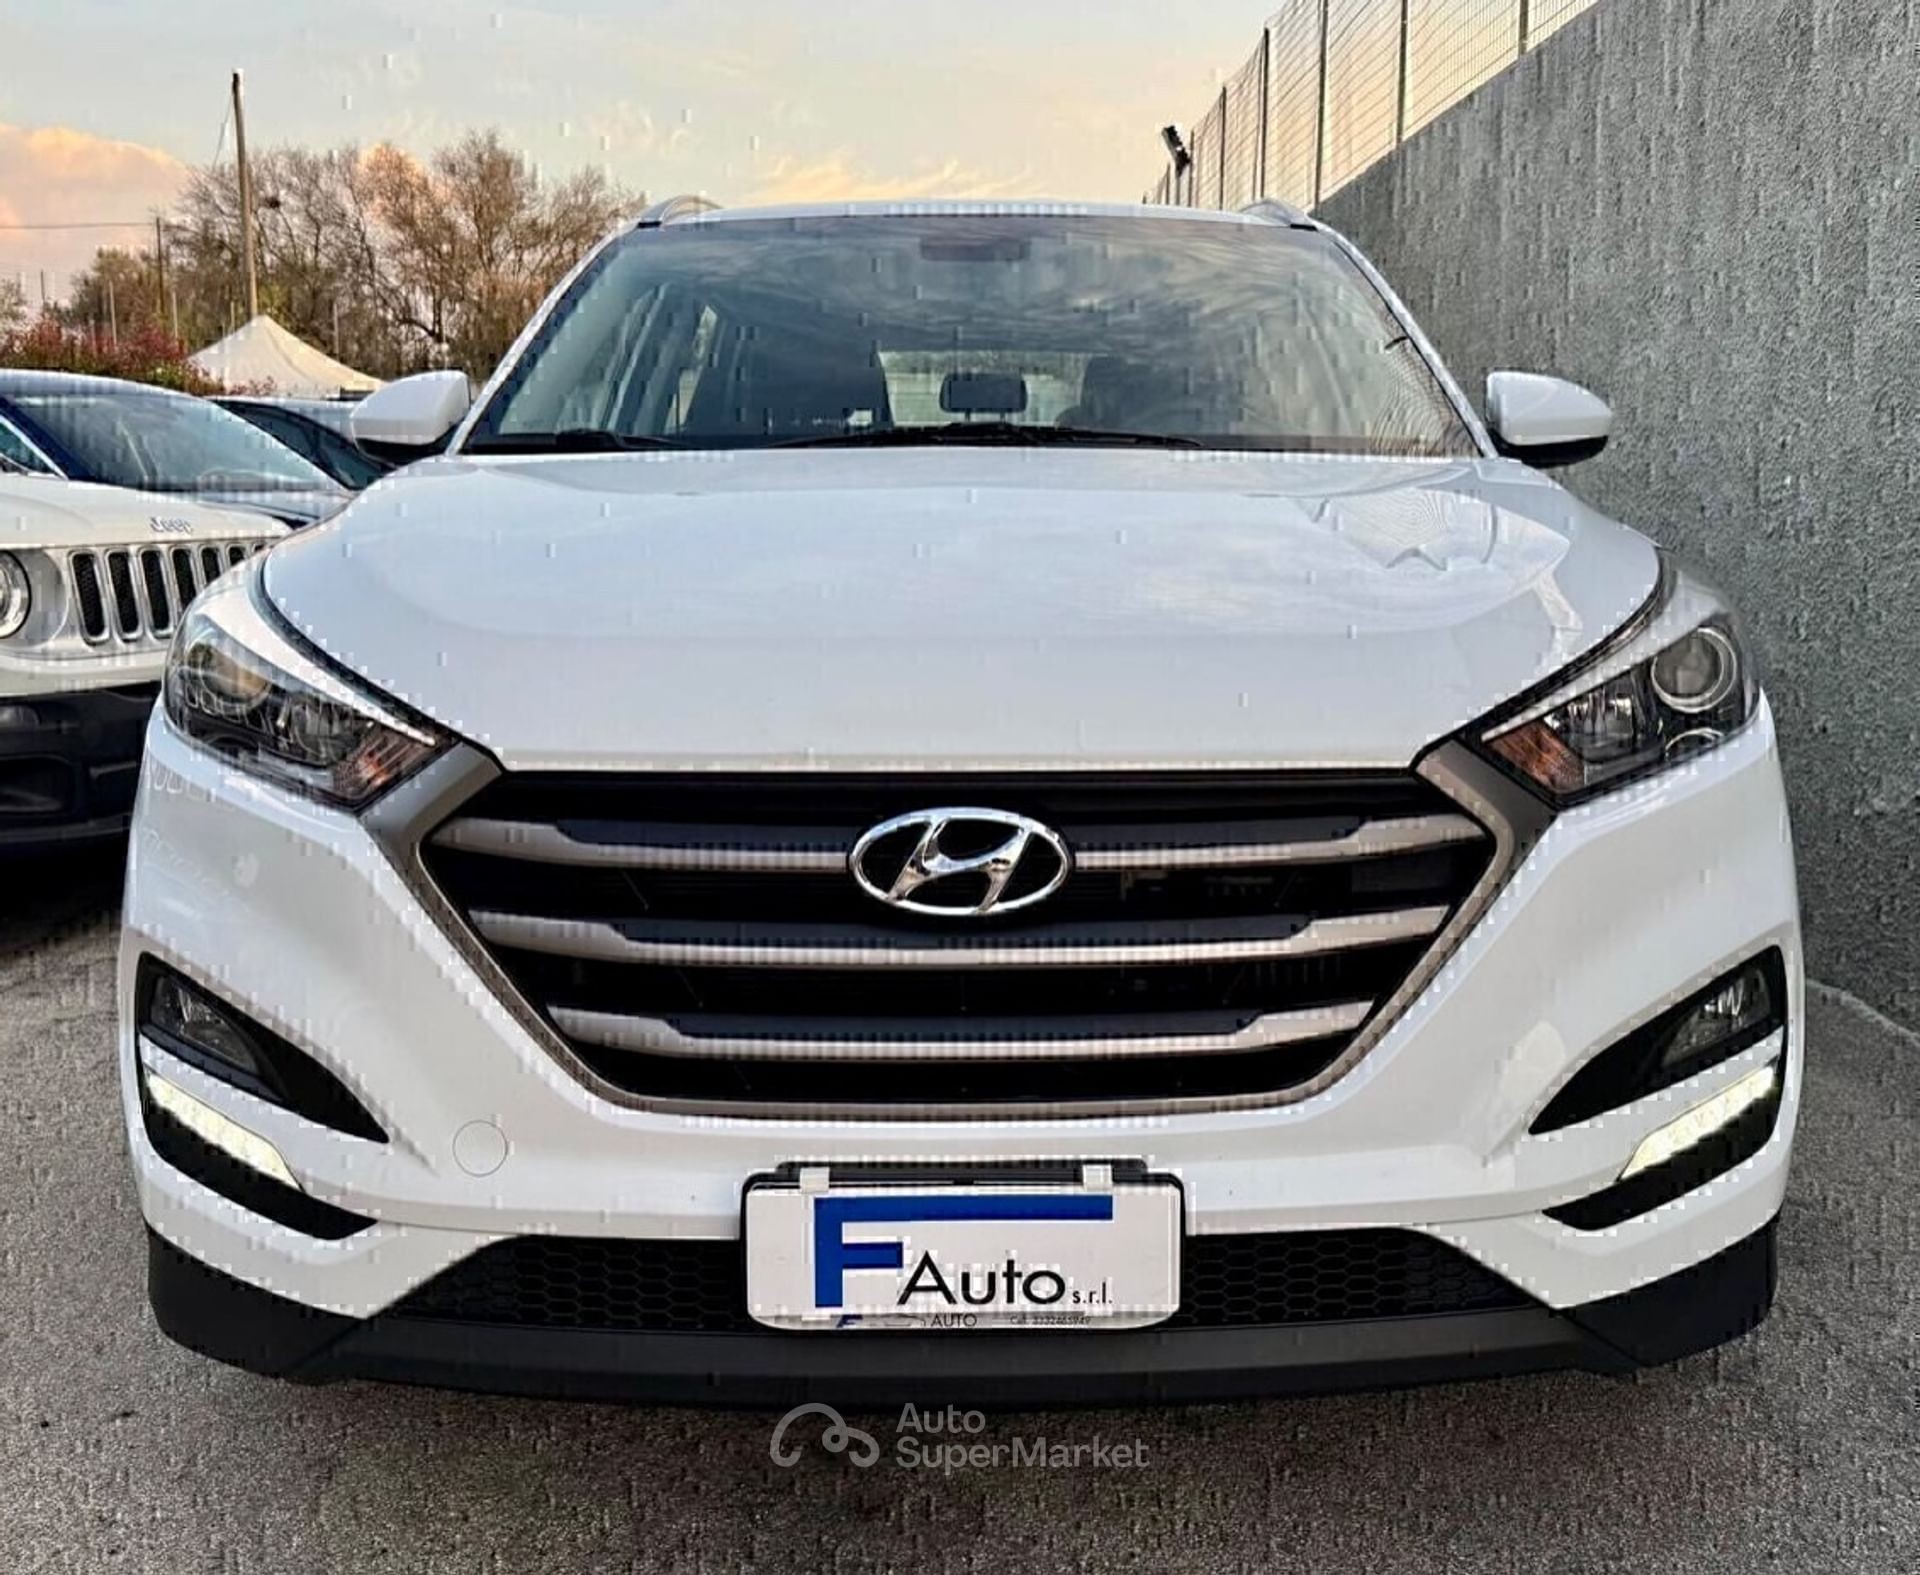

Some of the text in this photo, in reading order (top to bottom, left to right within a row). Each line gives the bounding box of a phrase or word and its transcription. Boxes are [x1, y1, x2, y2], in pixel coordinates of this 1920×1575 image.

[896, 1250, 1067, 1306] Auto
[1071, 1278, 1114, 1305] s.r.l.
[931, 1313, 978, 1327] AUTO
